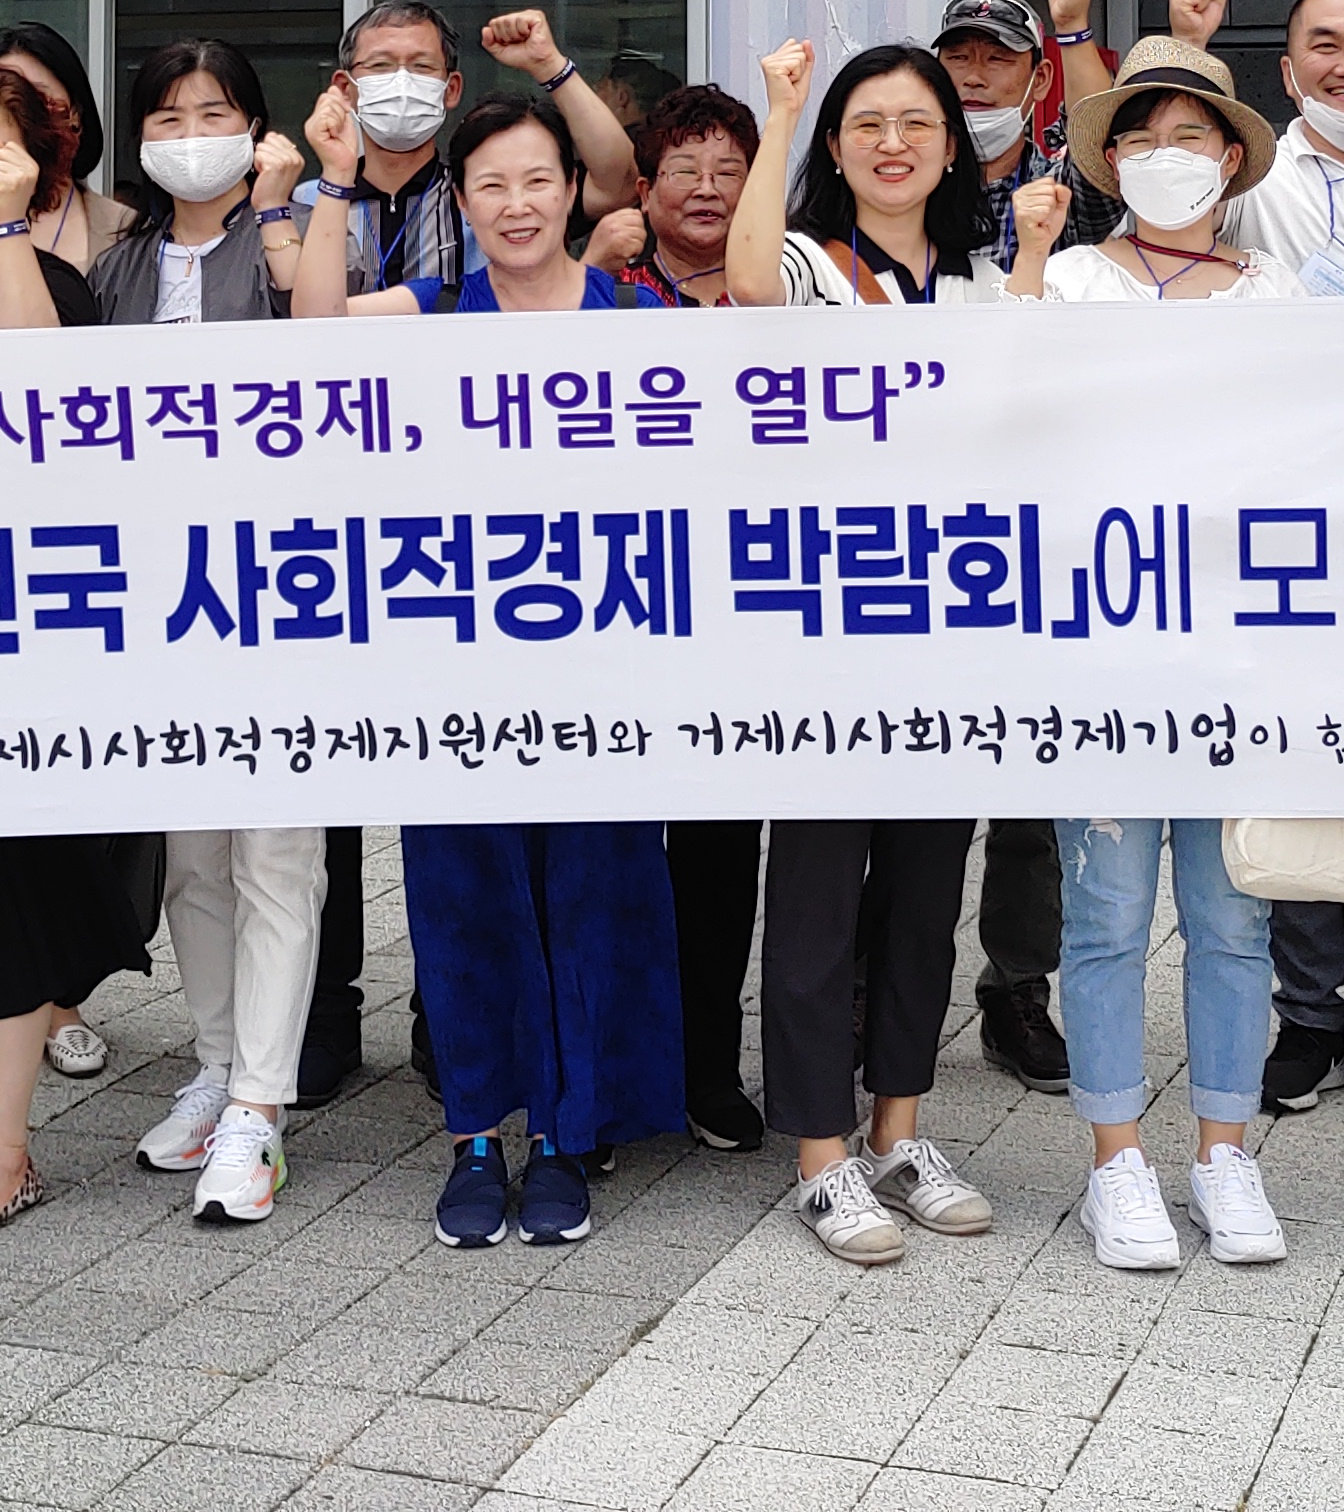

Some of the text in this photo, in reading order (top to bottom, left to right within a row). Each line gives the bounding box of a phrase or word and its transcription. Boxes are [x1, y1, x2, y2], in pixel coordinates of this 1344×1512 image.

[459, 366, 703, 450] 내일을
[166, 508, 693, 648] 사회적경제
[677, 703, 1289, 768] 거제시사회적경제기업이
